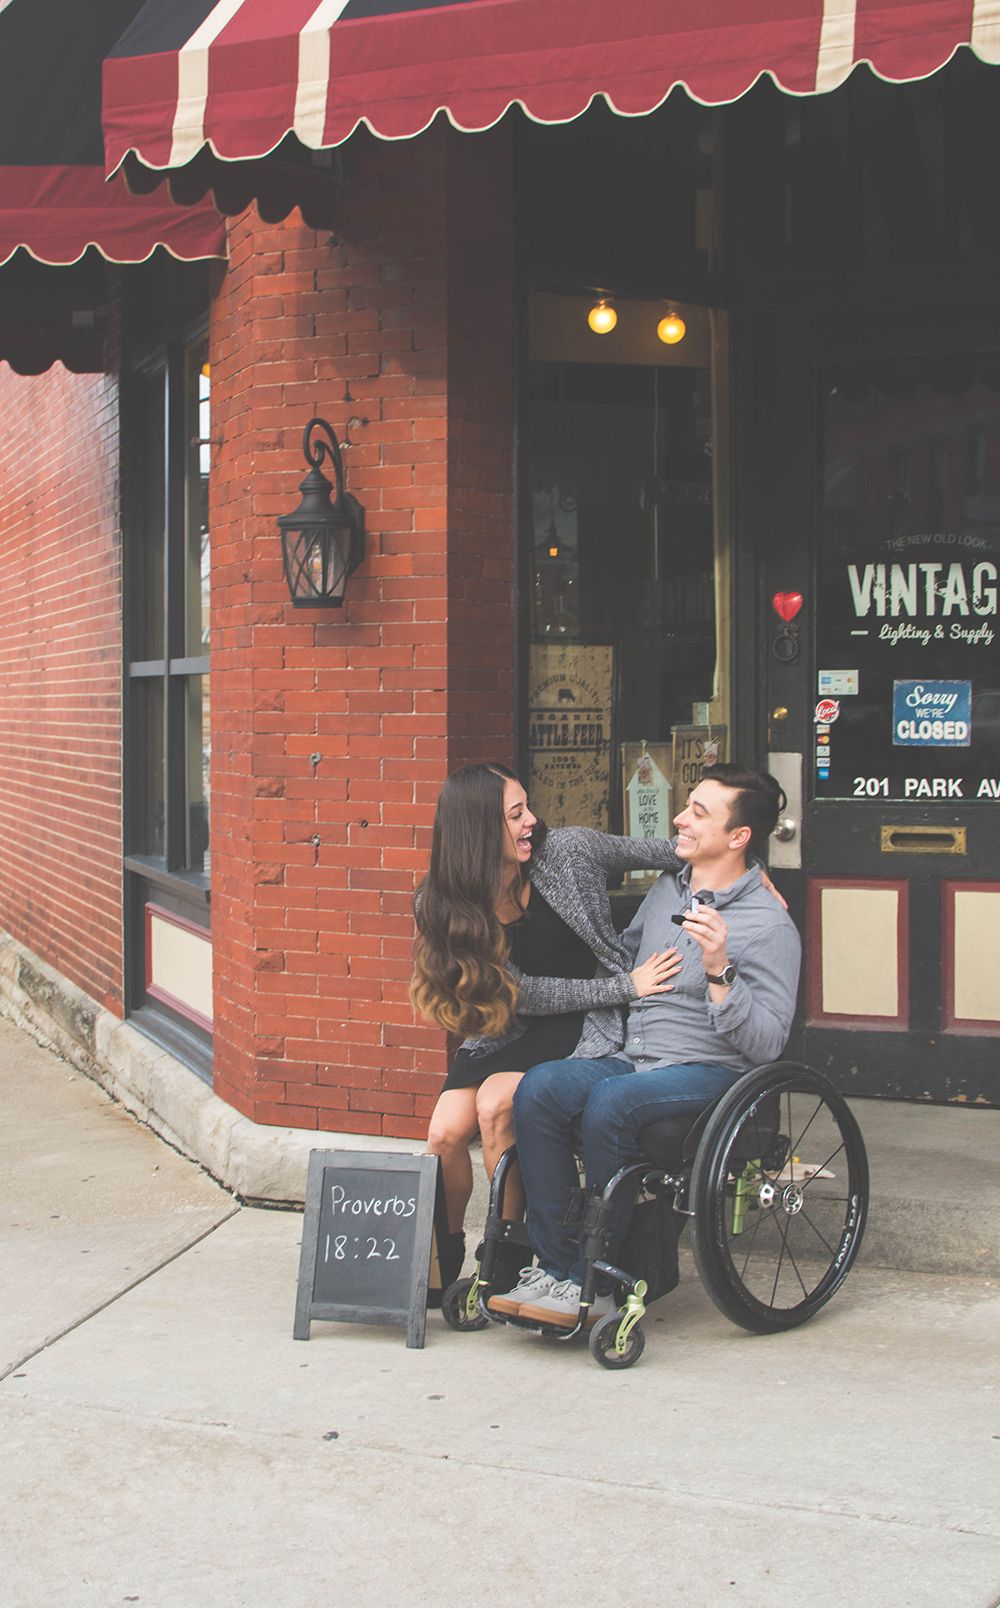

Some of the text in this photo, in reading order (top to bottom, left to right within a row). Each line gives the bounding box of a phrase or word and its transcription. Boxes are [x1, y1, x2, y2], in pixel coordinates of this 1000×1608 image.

[885, 533, 988, 549] THE NEW OLD LOOK
[847, 561, 998, 617] VINTAG
[879, 622, 996, 646] Lighting & Supply
[905, 685, 959, 714] Sorry
[914, 708, 945, 719] WE'RE
[896, 720, 968, 740] CLOSED
[852, 777, 889, 797] 201
[904, 778, 963, 798] PARK
[331, 1185, 416, 1217] Proverbs
[324, 1234, 400, 1263] 18:22
